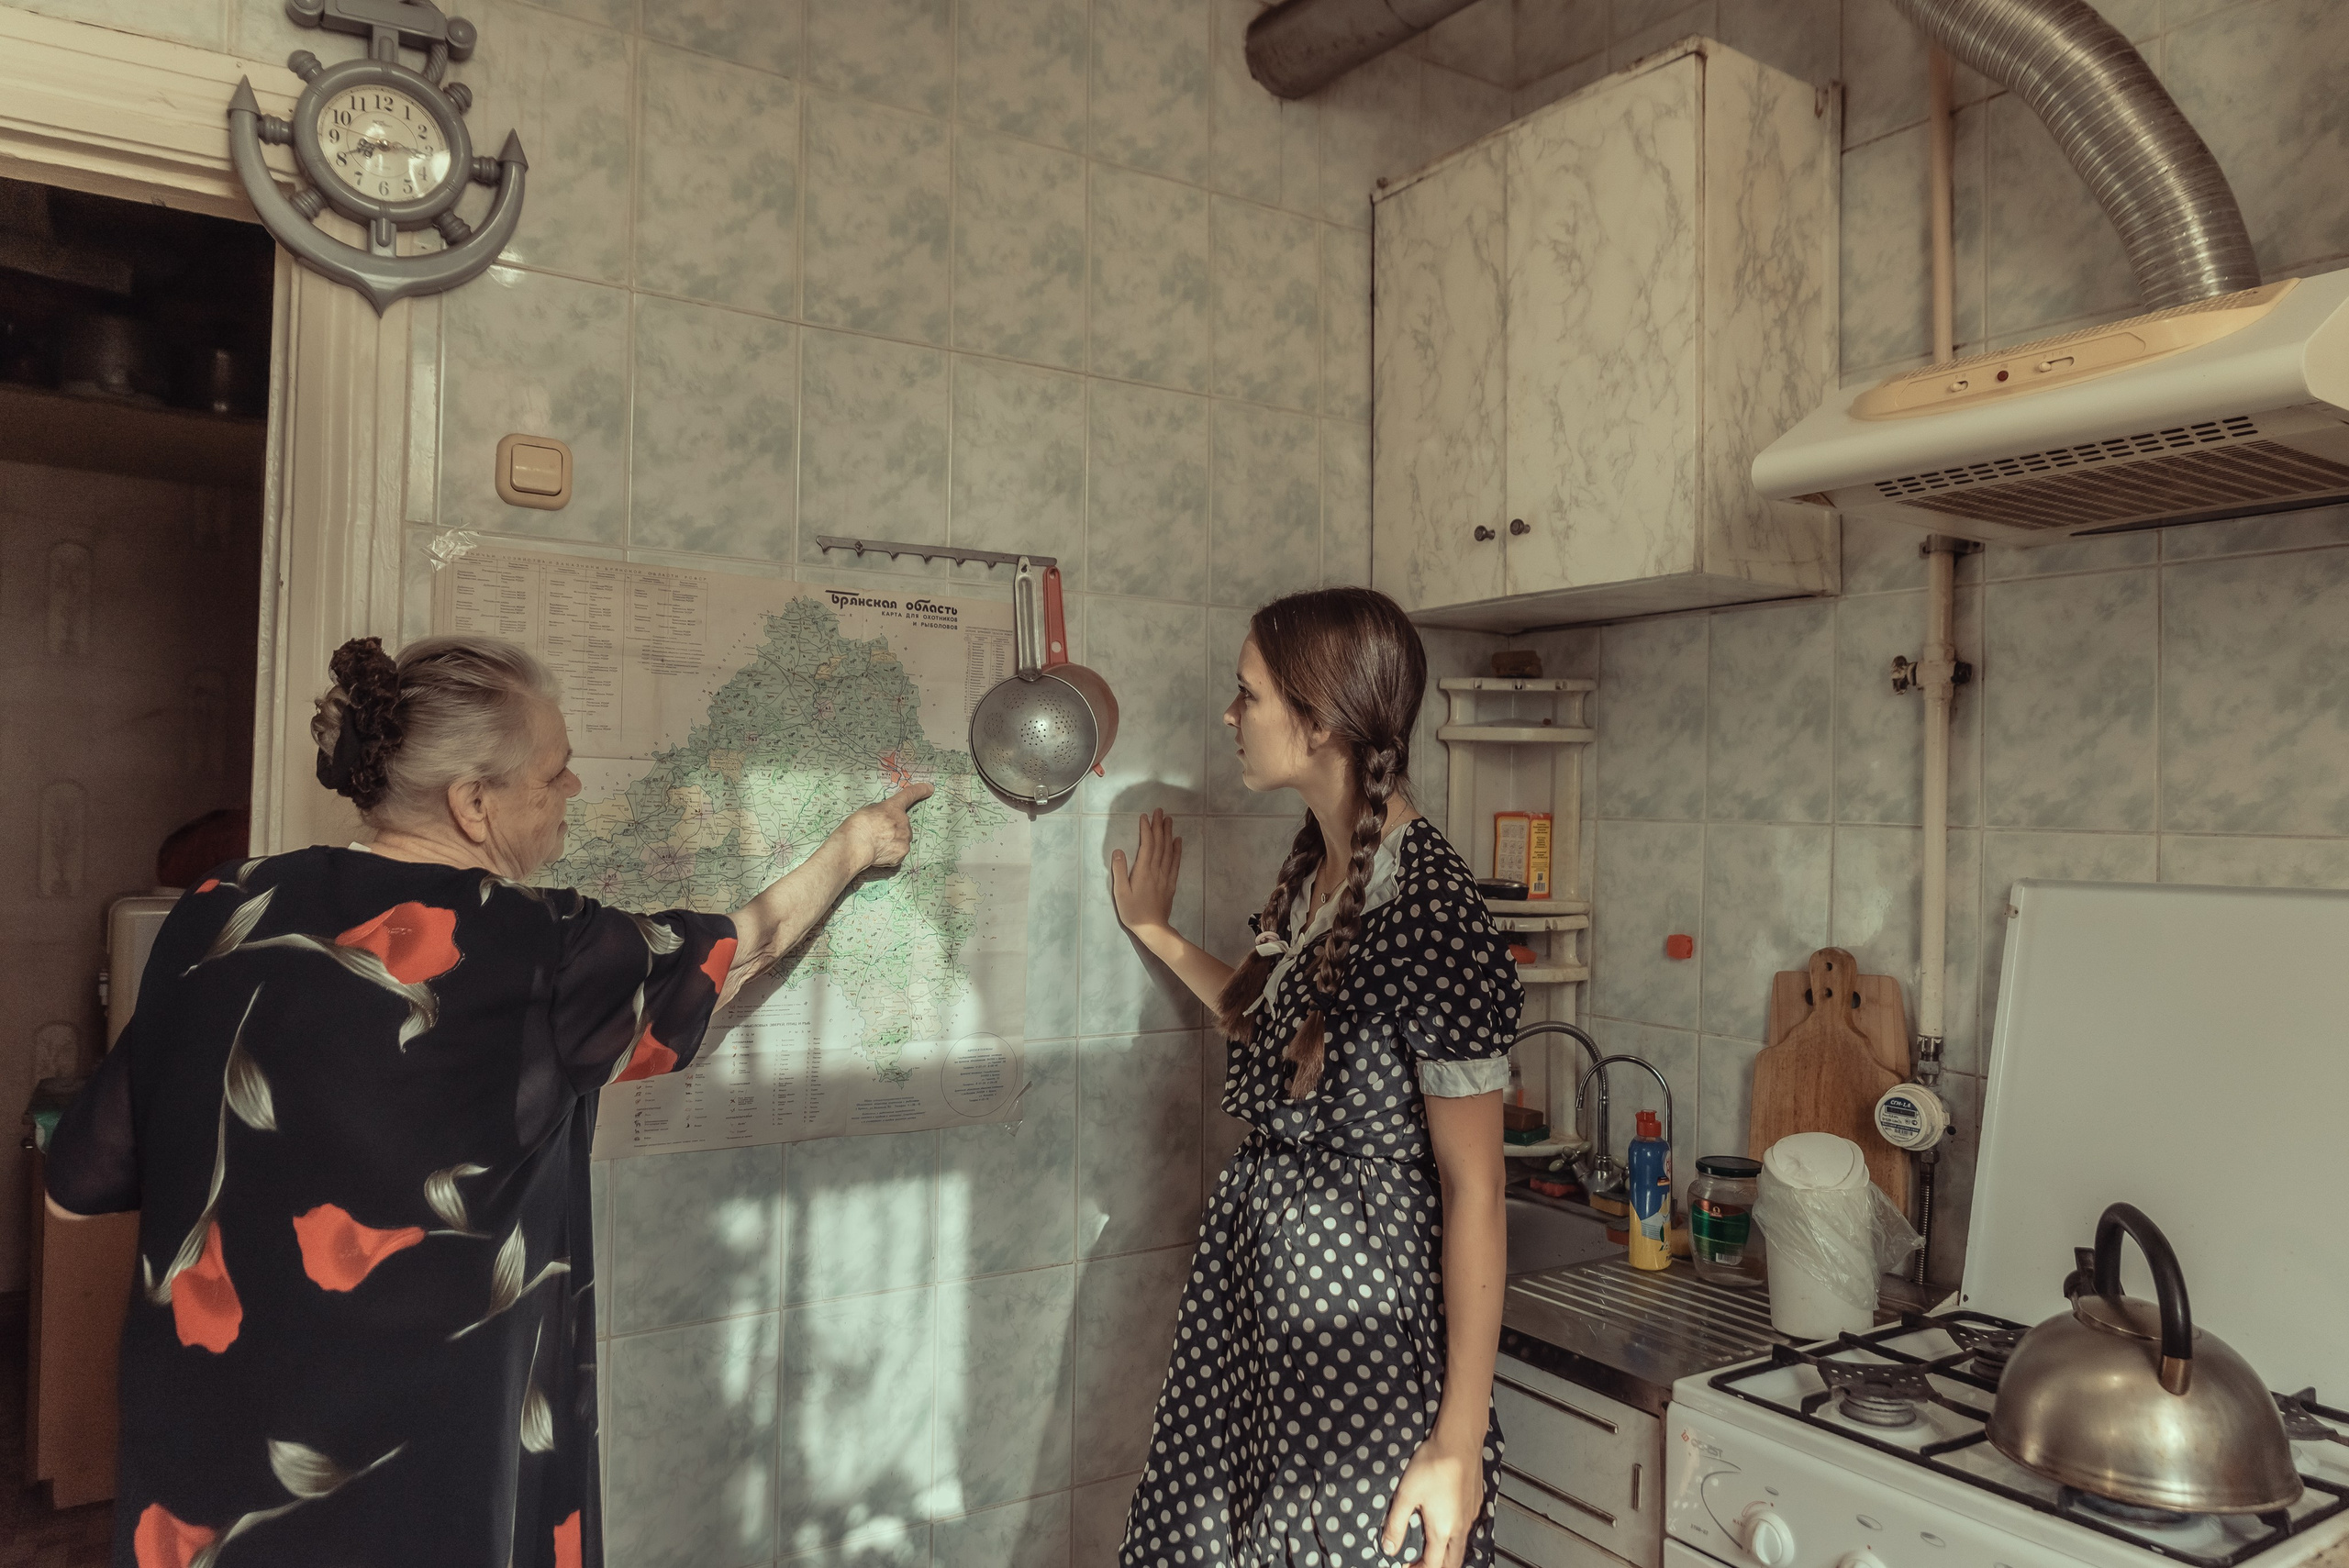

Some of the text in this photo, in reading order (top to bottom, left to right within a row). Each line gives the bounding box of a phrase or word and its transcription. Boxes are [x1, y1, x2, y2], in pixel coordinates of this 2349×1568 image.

[350, 95, 366, 112] 11
[374, 95, 394, 112] 12
[332, 109, 351, 126] 10
[404, 106, 410, 121] 1
[328, 128, 340, 144] 9
[417, 124, 428, 139] 2
[336, 151, 348, 167] 8
[354, 171, 363, 185] 7
[418, 166, 428, 181] 4
[378, 181, 390, 196] 6
[403, 178, 413, 194] 5
[920, 622, 958, 630] РЫБОЛОВОВ
[922, 614, 958, 623] ОХОТНИКОВ
